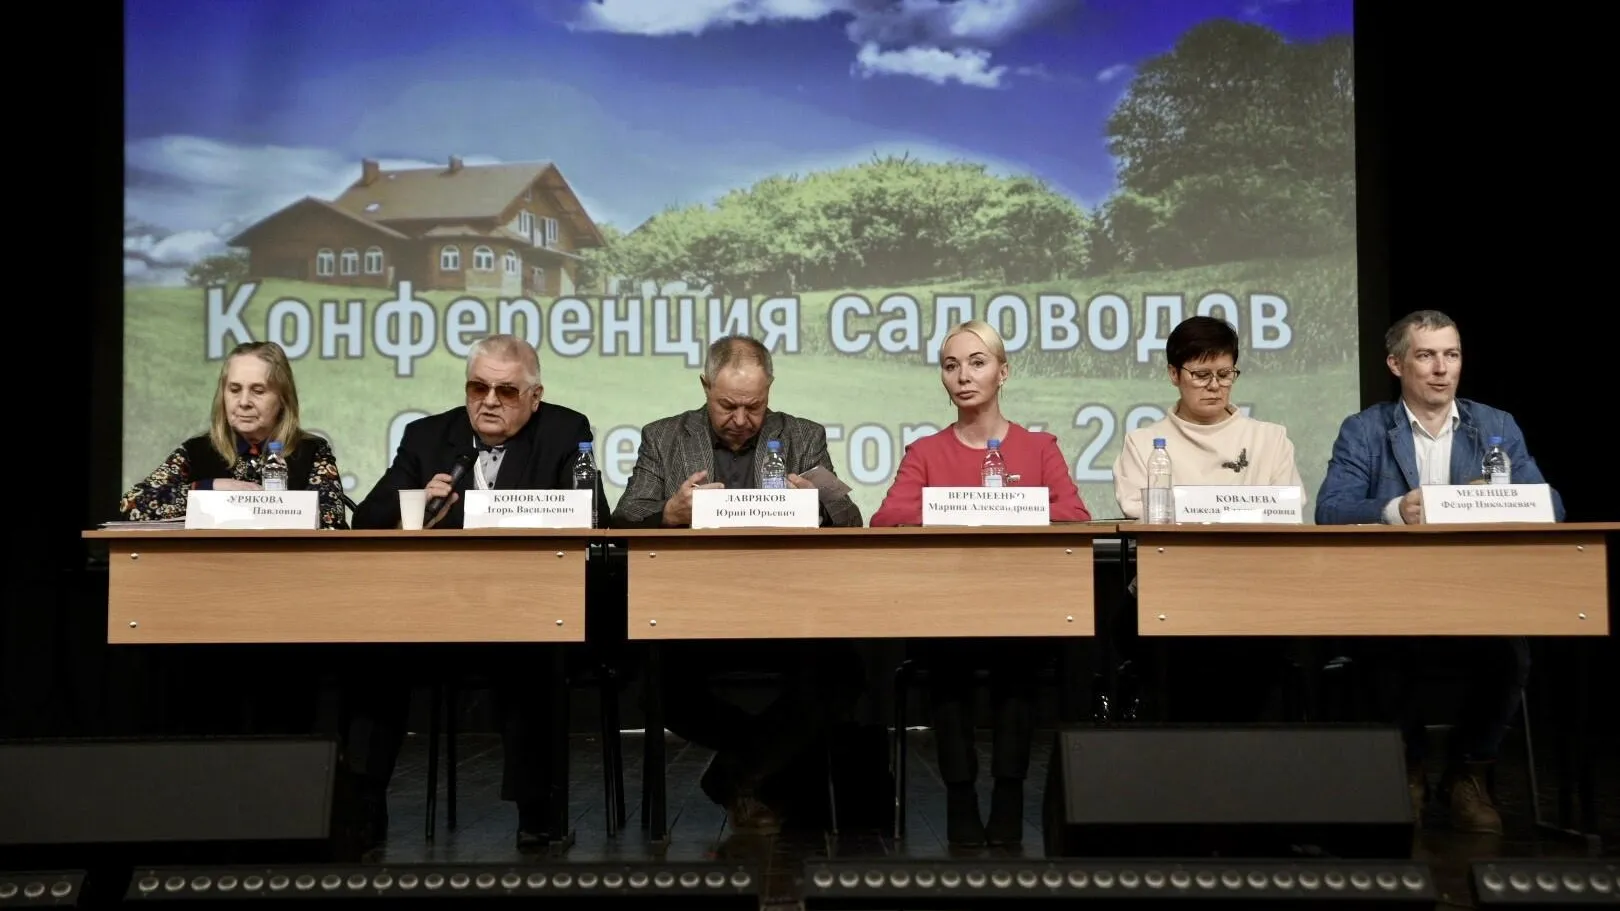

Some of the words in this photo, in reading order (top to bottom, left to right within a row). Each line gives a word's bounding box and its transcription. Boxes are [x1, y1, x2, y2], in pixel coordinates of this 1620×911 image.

[206, 281, 800, 377] Конференция
[948, 491, 1025, 500] ВЕРЕМЕЕНКО
[1457, 489, 1518, 497] МЕЗЕНЦЕВ
[226, 495, 284, 504] УРЯКОВА
[494, 495, 566, 503] КОНОВАЛОВ
[725, 494, 786, 502] ЛАВРЯКОВ
[1216, 495, 1278, 503] КОВАЛЕВА
[928, 503, 967, 512] Марина
[1475, 500, 1537, 508] Николаевич
[253, 507, 302, 515] Павловна
[517, 505, 575, 514] Васильевич
[716, 508, 746, 518] Юрий
[749, 508, 795, 518] Юрьевич
[1184, 506, 1220, 514] Анжела
